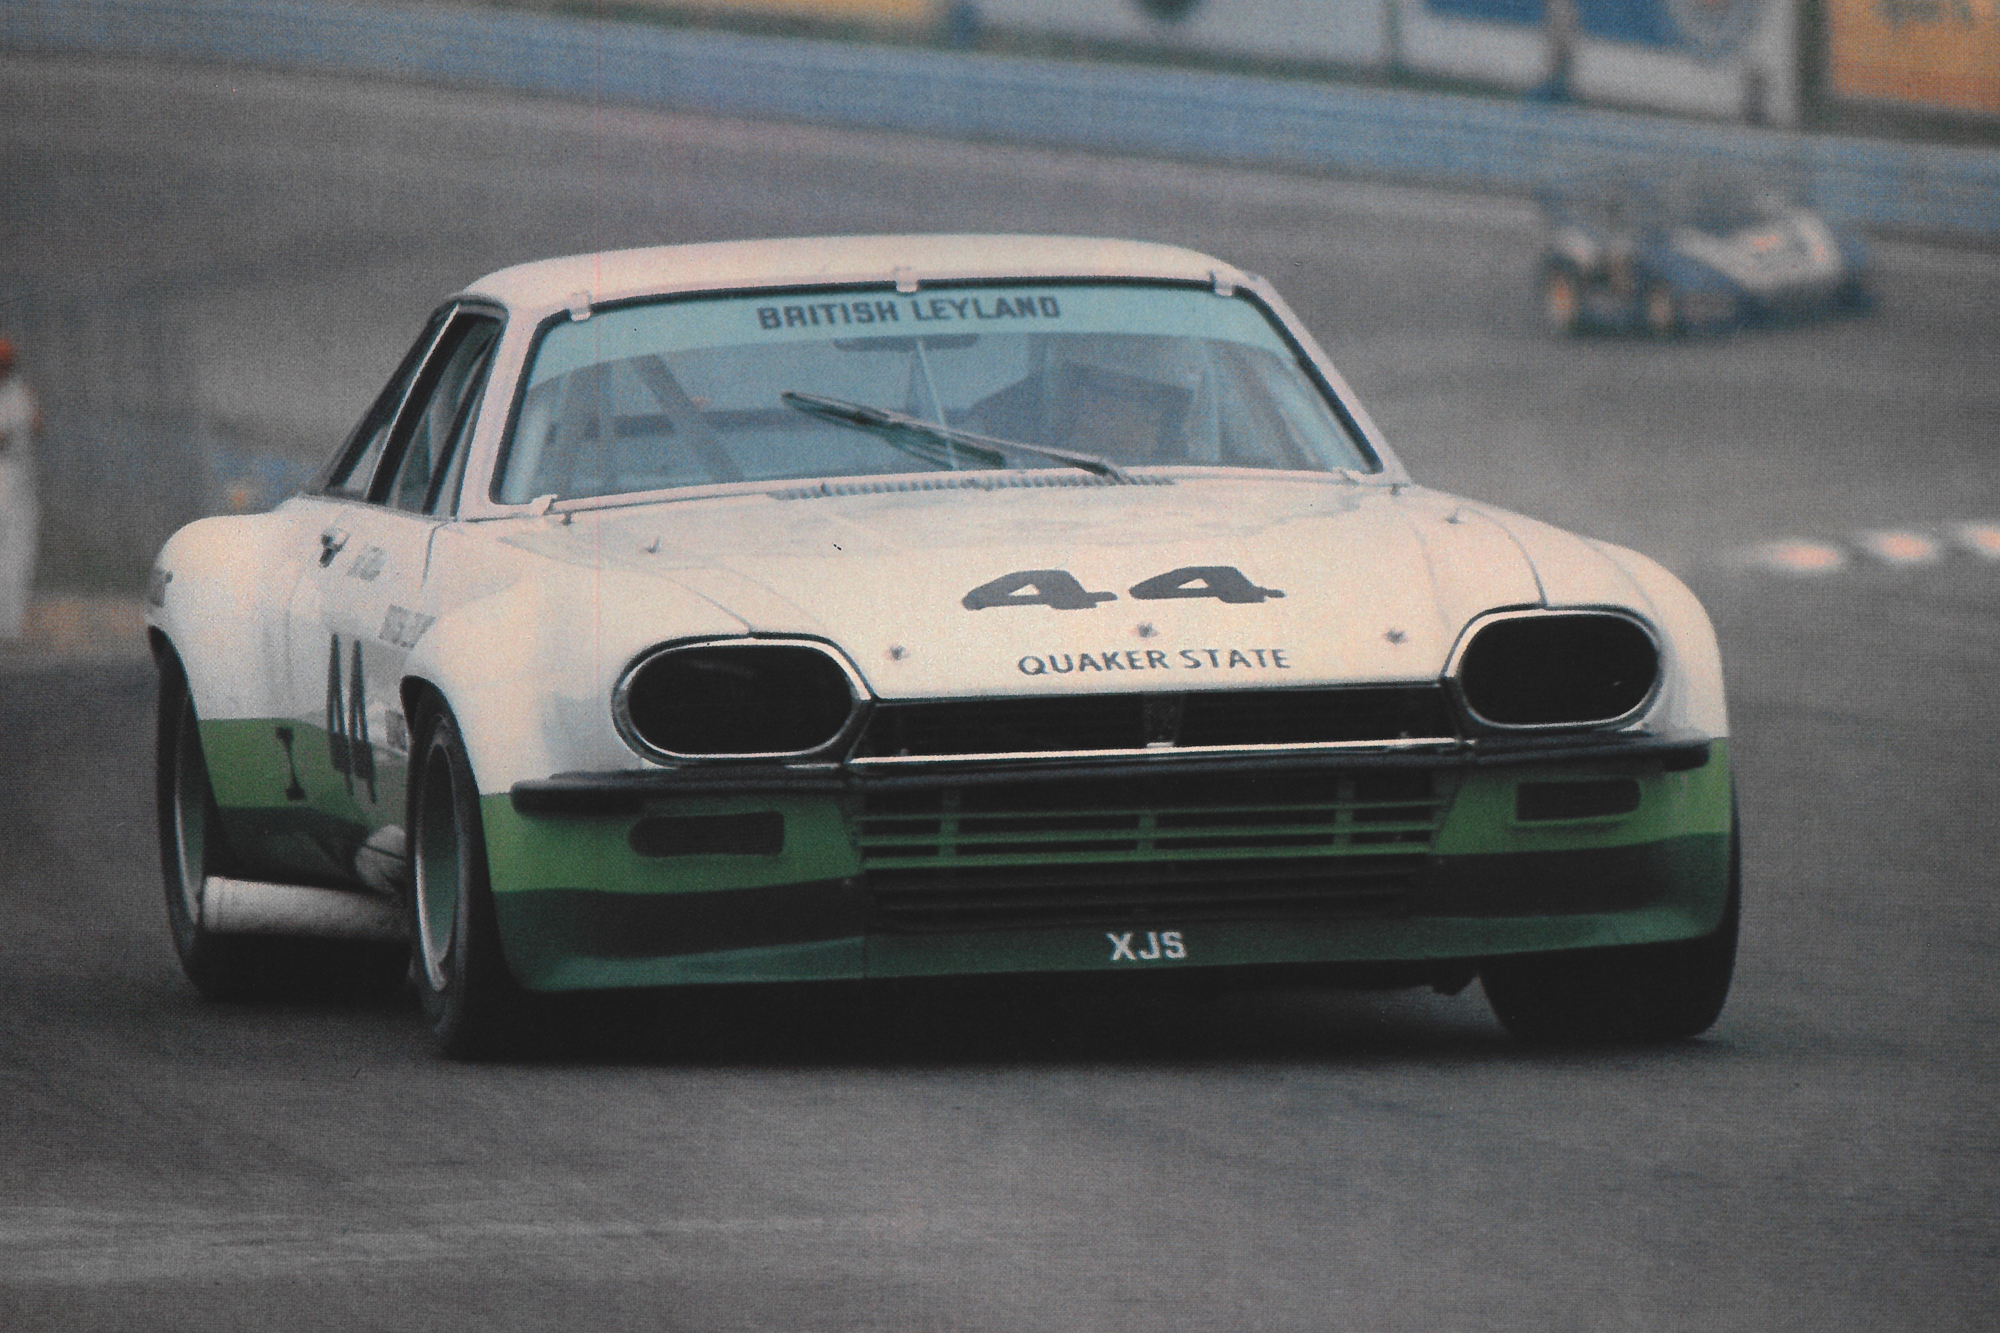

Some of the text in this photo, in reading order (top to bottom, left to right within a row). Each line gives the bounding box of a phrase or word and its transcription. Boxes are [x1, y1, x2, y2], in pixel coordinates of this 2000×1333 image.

[757, 296, 1060, 330] BRITISH LEYLAND
[961, 565, 1285, 611] 44
[1017, 648, 1291, 676] QUAKER STATE
[1105, 930, 1187, 961] XJS
